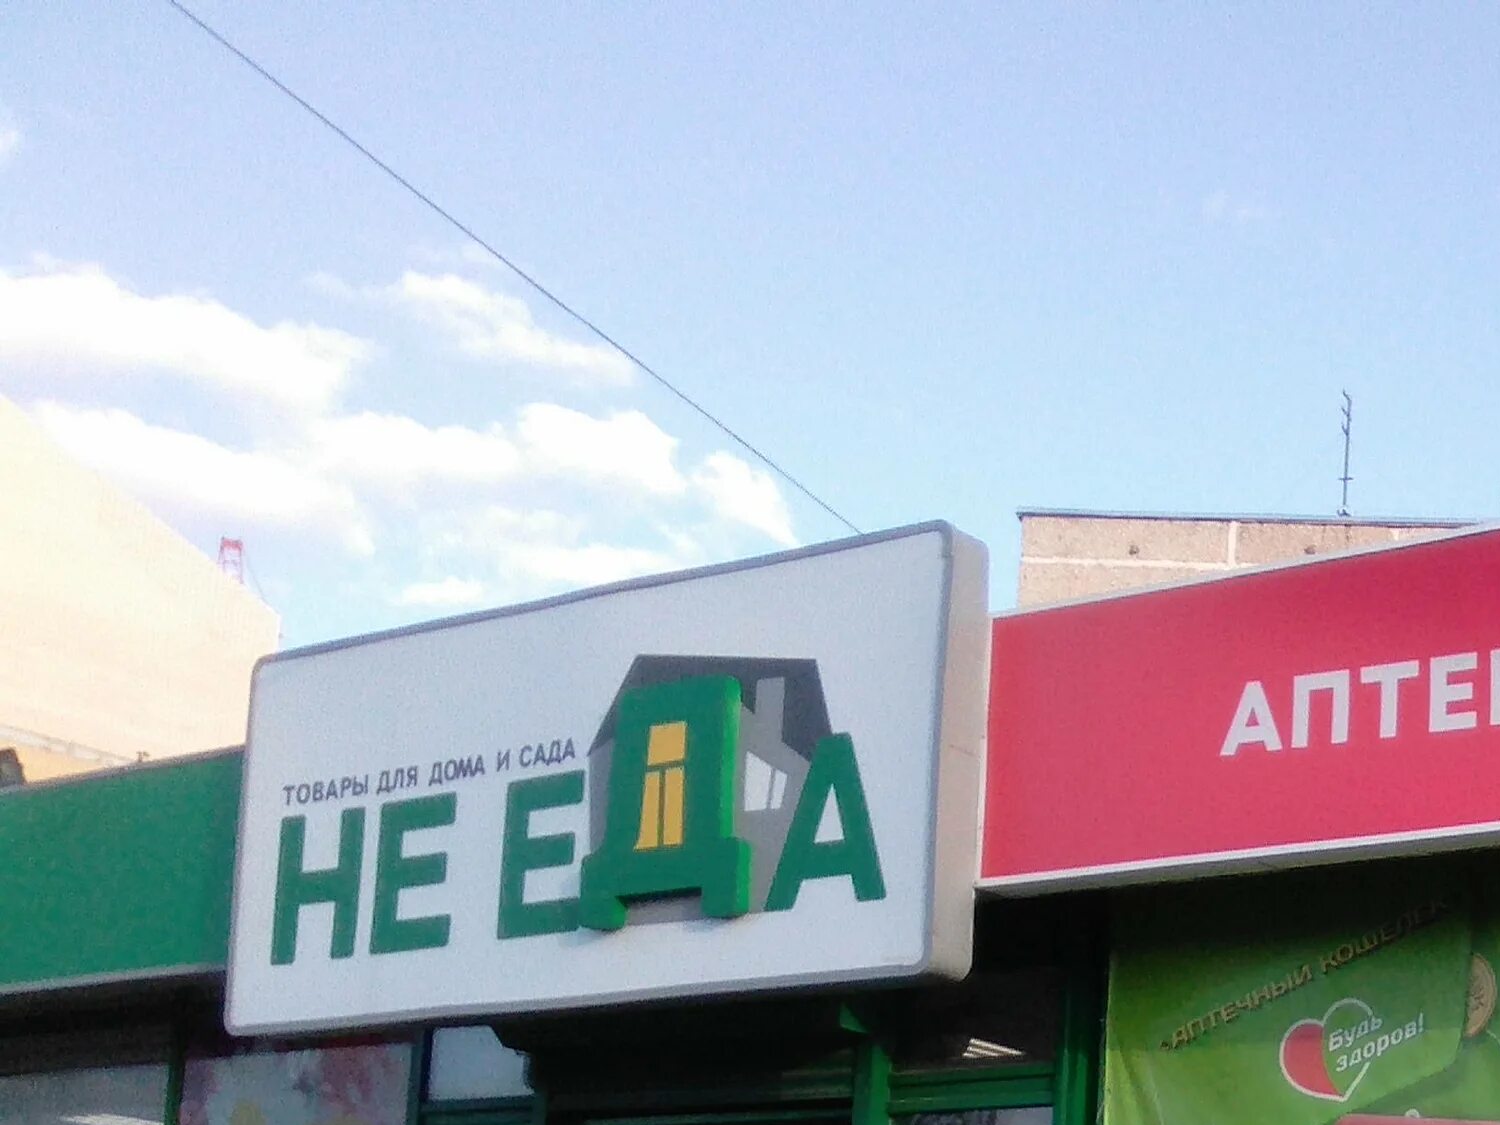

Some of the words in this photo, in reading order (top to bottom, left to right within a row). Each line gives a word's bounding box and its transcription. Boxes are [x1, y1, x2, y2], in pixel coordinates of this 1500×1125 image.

[283, 774, 369, 805] ТОВАРЫ
[376, 765, 418, 795] ДЛЯ
[428, 754, 486, 787] ДОМА
[496, 749, 511, 772] И
[519, 737, 576, 766] САДА
[270, 792, 458, 966] НЕ
[497, 674, 887, 940] ЕДА
[1328, 1015, 1384, 1052] Будь
[1335, 1012, 1425, 1073] здоров!
